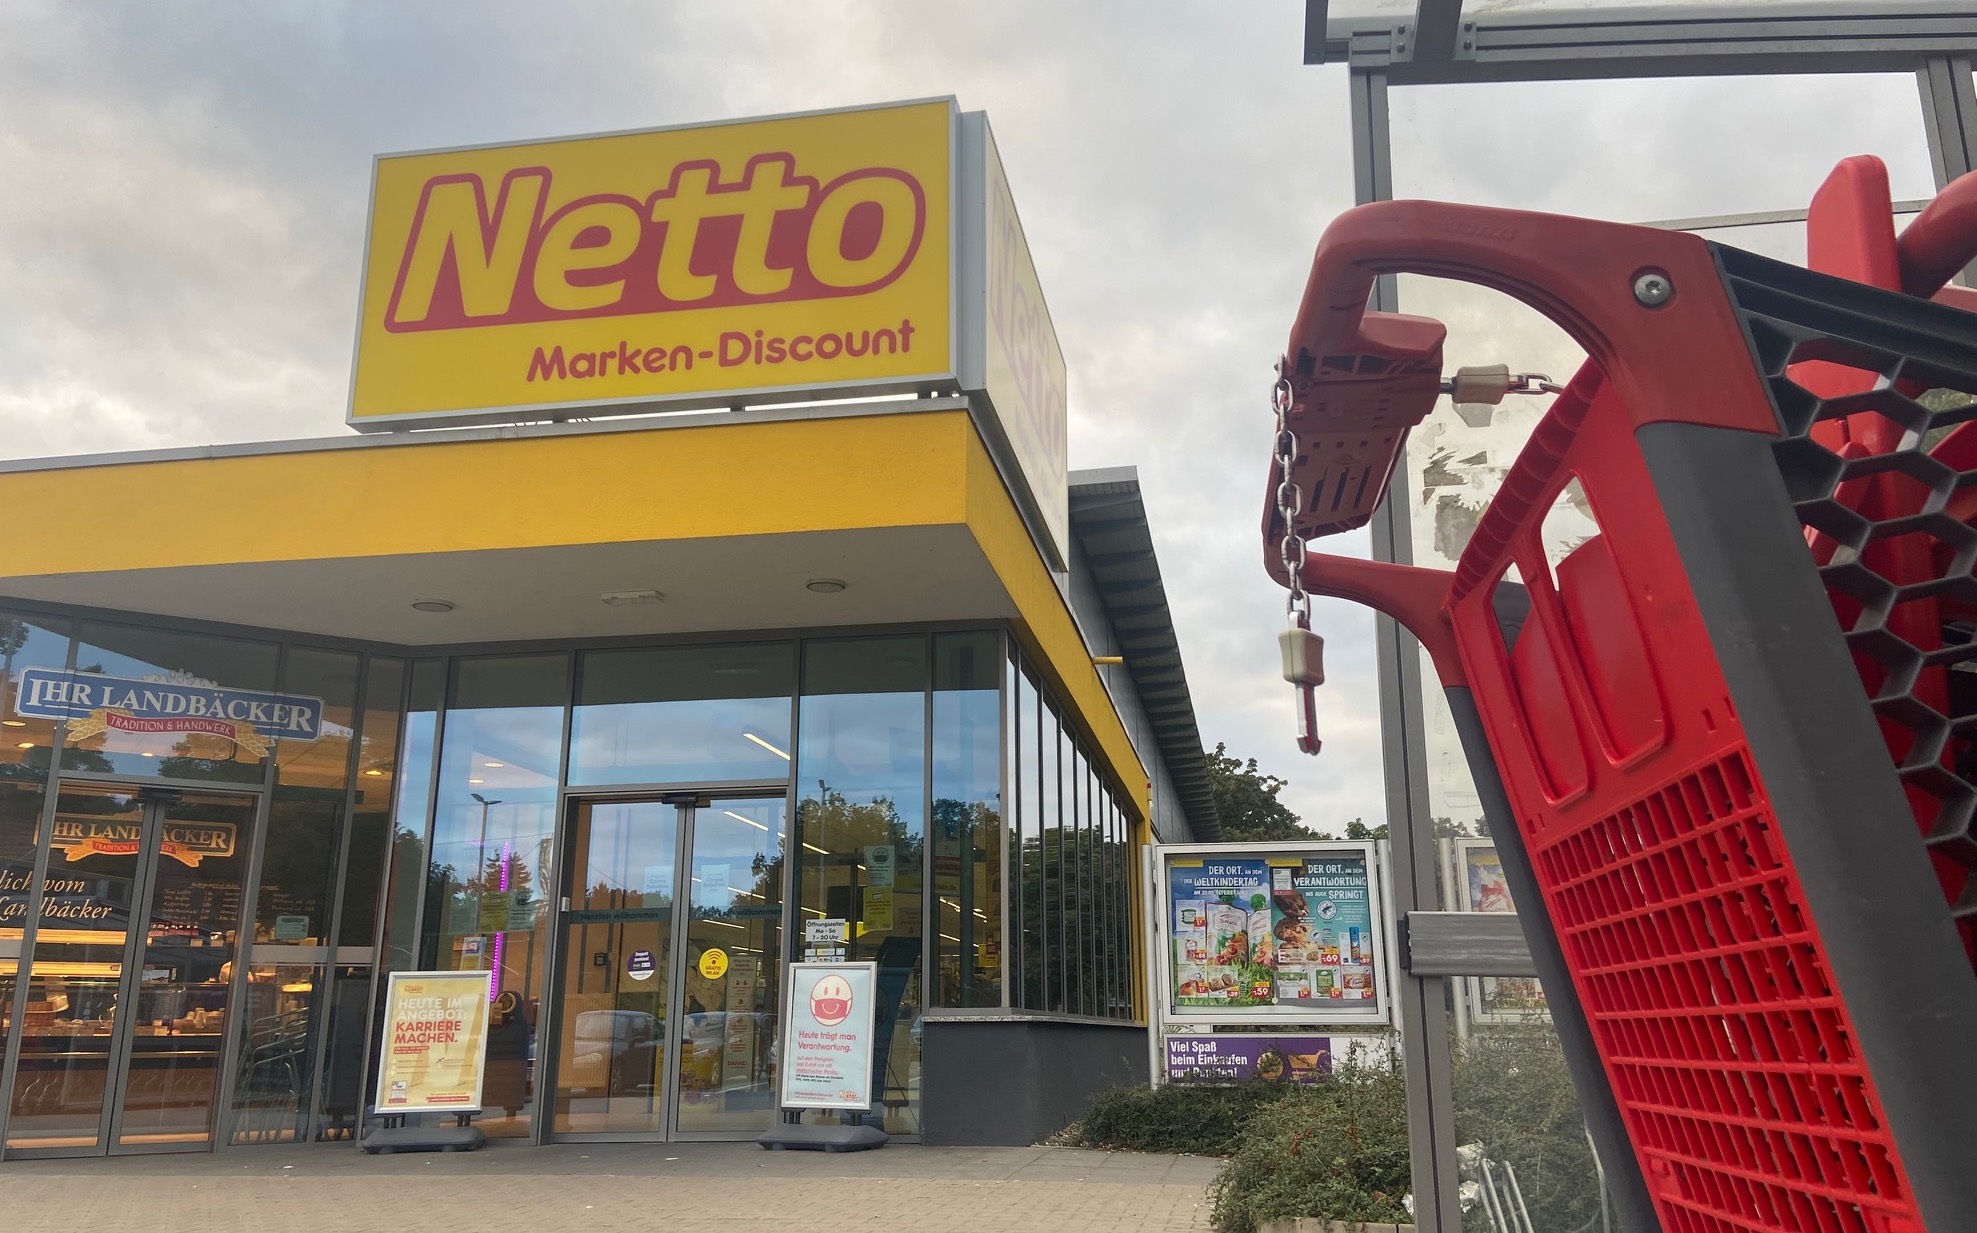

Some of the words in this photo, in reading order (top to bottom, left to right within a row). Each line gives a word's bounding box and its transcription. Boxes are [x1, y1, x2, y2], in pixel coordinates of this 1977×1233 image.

[386, 152, 925, 332] Netto
[526, 319, 915, 382] Marken-Discount
[26, 678, 92, 707] IHR
[102, 686, 314, 732] LANDBÄCKER
[110, 715, 165, 731] TRADITION
[166, 721, 174, 731] &
[176, 721, 233, 736] HANDWERK
[53, 821, 83, 837] HR
[89, 823, 227, 849] LANDÄCKER
[1208, 865, 1224, 875] DER
[1307, 864, 1324, 874] DER
[42, 880, 85, 893] vom
[1193, 877, 1259, 887] WELTKINDERTAG
[1293, 876, 1367, 887] VERANTWORTUNG
[1328, 890, 1366, 900] SPRINGT.
[580, 911, 612, 920] Herzlich
[613, 911, 659, 920] willkommen
[806, 920, 846, 928] Öffnungszeiten
[398, 998, 443, 1009] HEUTE
[447, 997, 463, 1009] IM
[395, 1020, 462, 1033] KARRIERE
[394, 1032, 458, 1044] MACHEN.
[798, 1030, 819, 1039] Heute
[819, 1031, 838, 1041] trägt
[839, 1033, 857, 1041] man
[797, 1041, 852, 1053] Verantwortung.
[1170, 1041, 1190, 1053] Viel
[1191, 1041, 1217, 1055] Spaß
[1171, 1054, 1196, 1065] beim
[1197, 1054, 1248, 1066] Einkaufen
